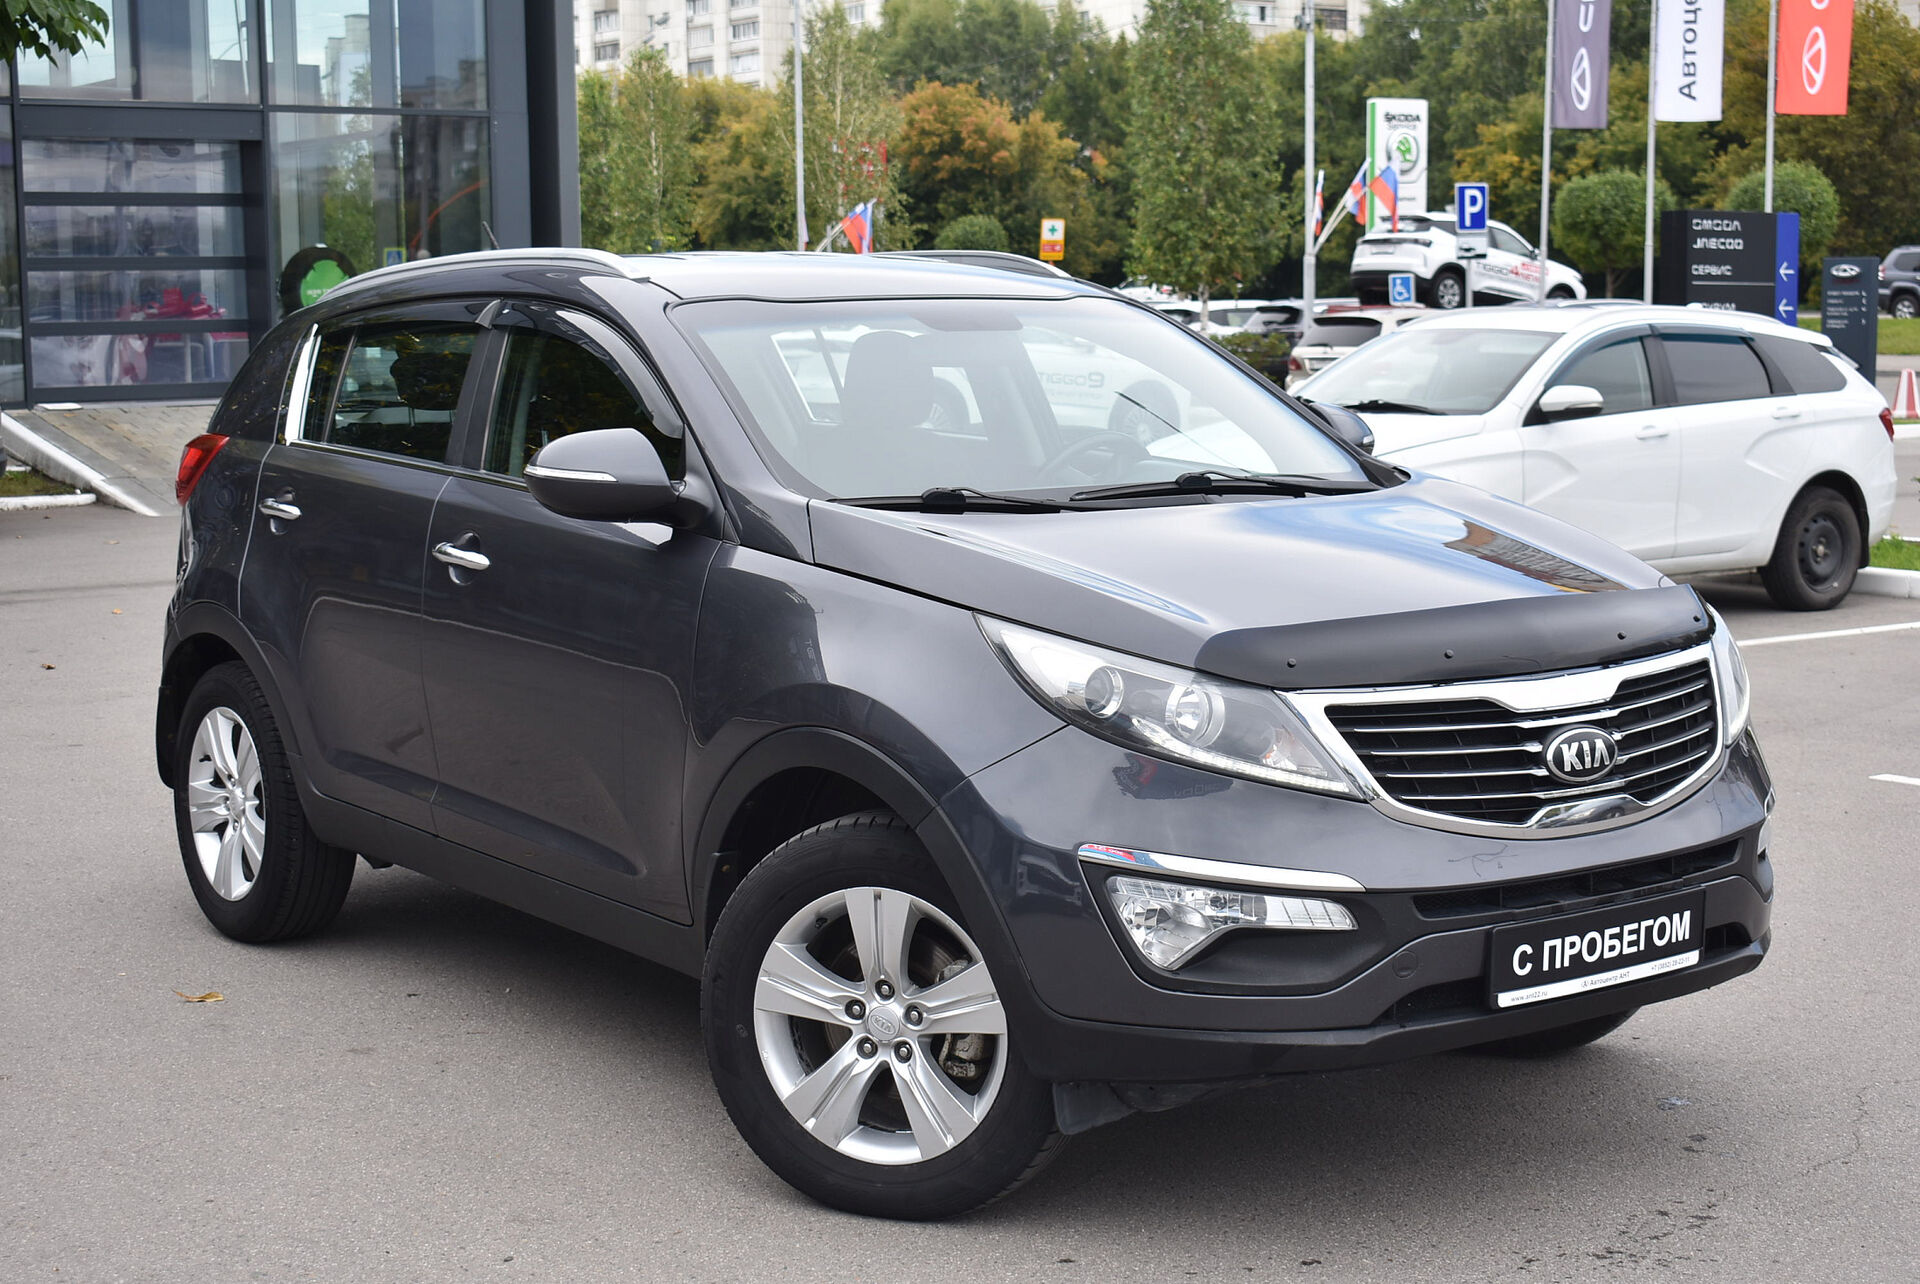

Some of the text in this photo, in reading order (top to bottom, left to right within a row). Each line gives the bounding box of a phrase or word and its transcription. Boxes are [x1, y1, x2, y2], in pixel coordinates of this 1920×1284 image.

[1464, 188, 1484, 227] P
[1691, 264, 1733, 276] СЕРВИС
[1560, 738, 1610, 772] KIA
[1512, 910, 1691, 976] С ПРОБЕГОМ
